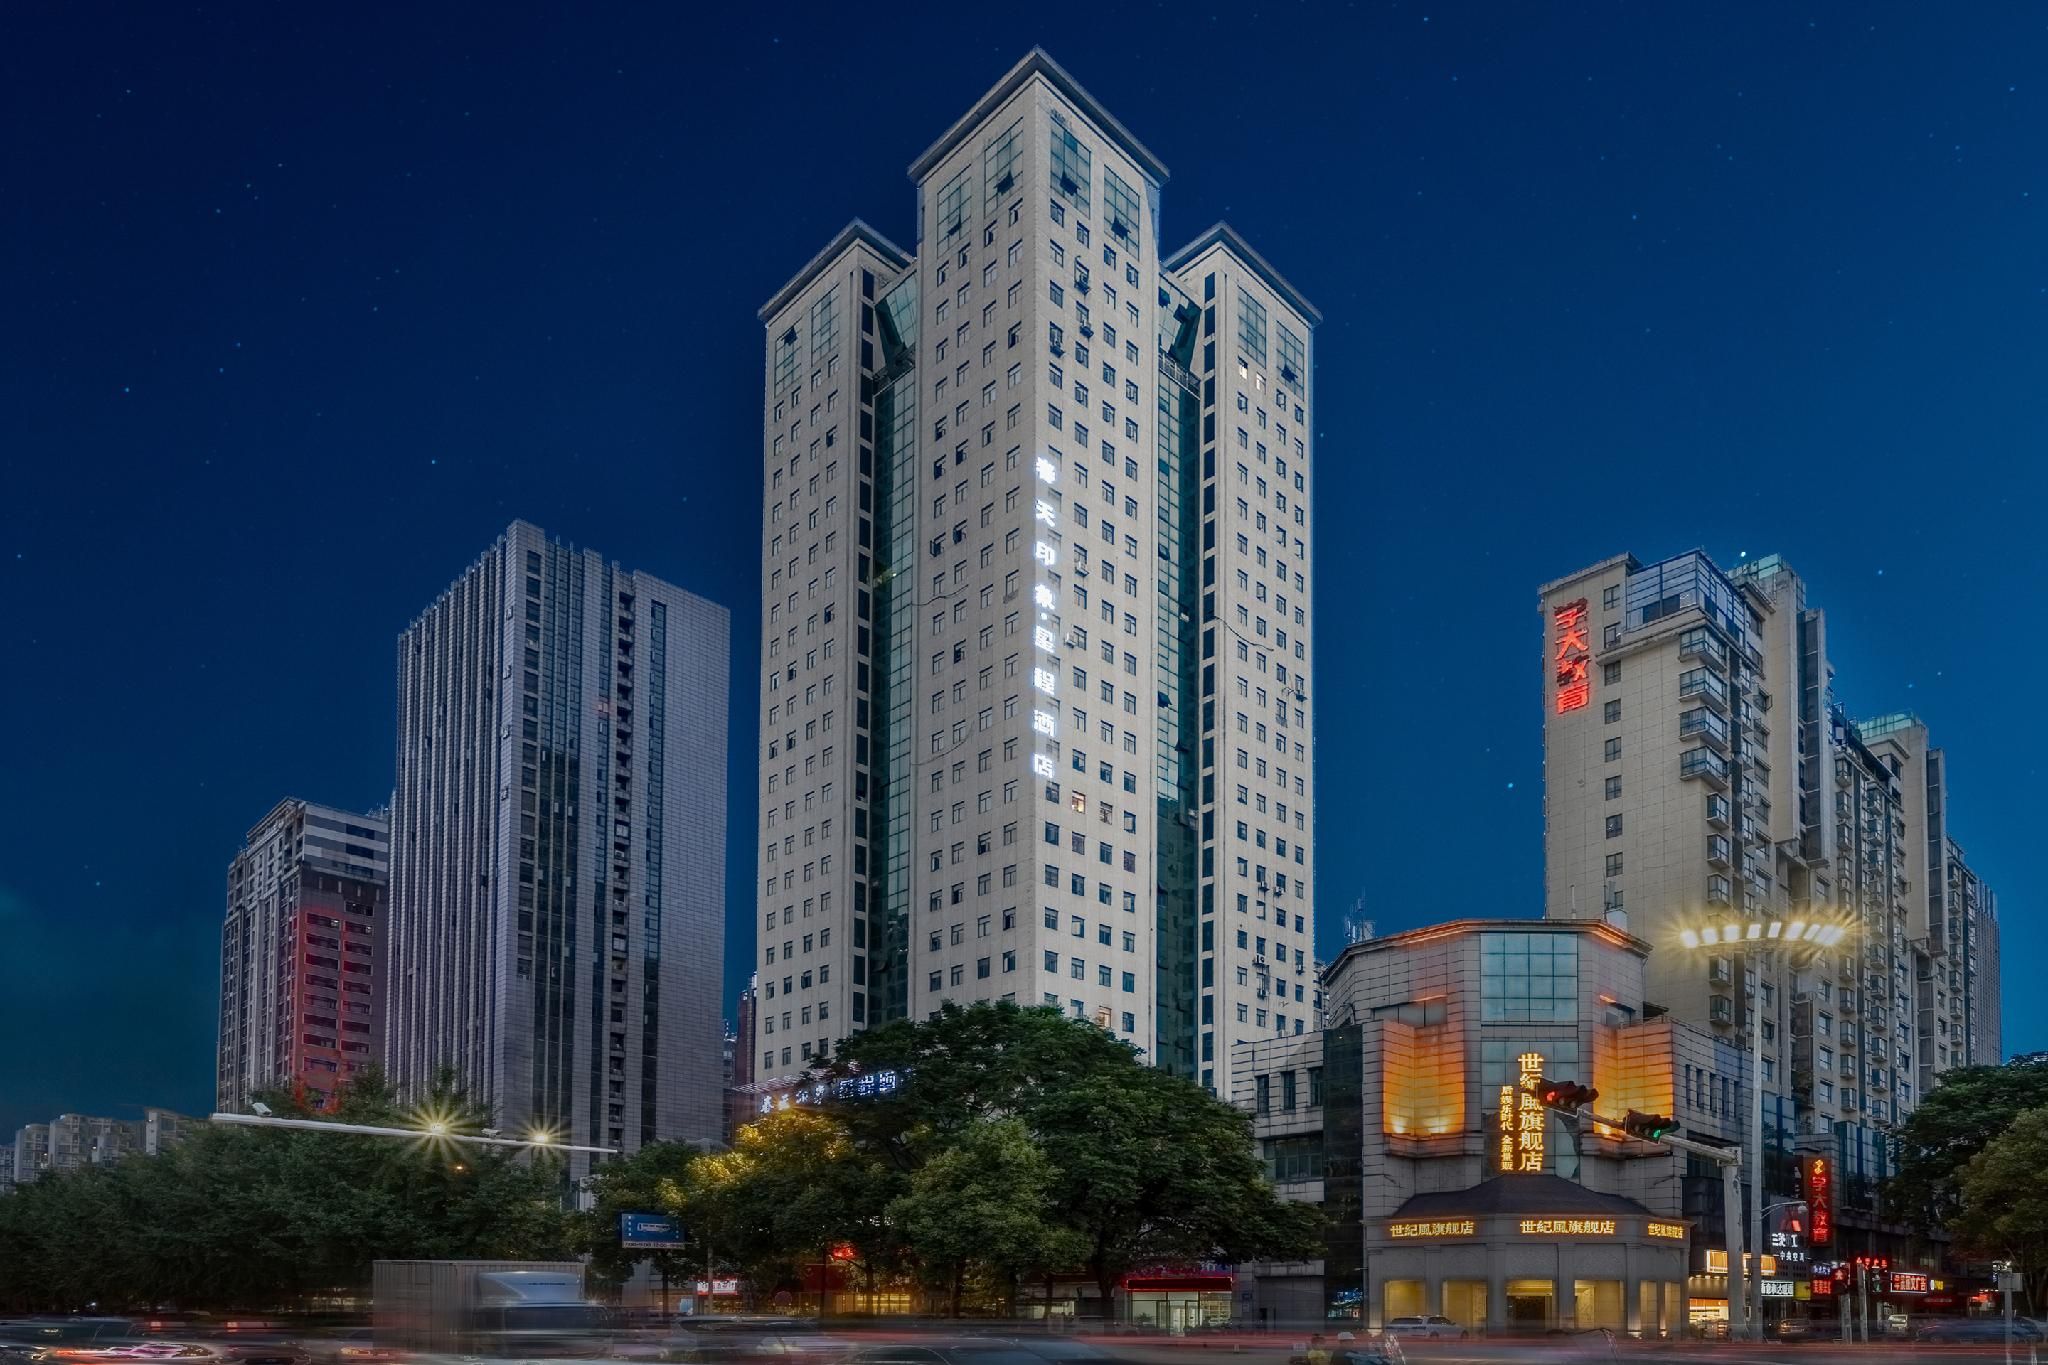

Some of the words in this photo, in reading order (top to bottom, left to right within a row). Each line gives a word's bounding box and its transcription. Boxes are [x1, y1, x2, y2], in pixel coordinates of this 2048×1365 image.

[1553, 597, 1591, 714] 学大教育
[1812, 1176, 1829, 1242] 学大教育
